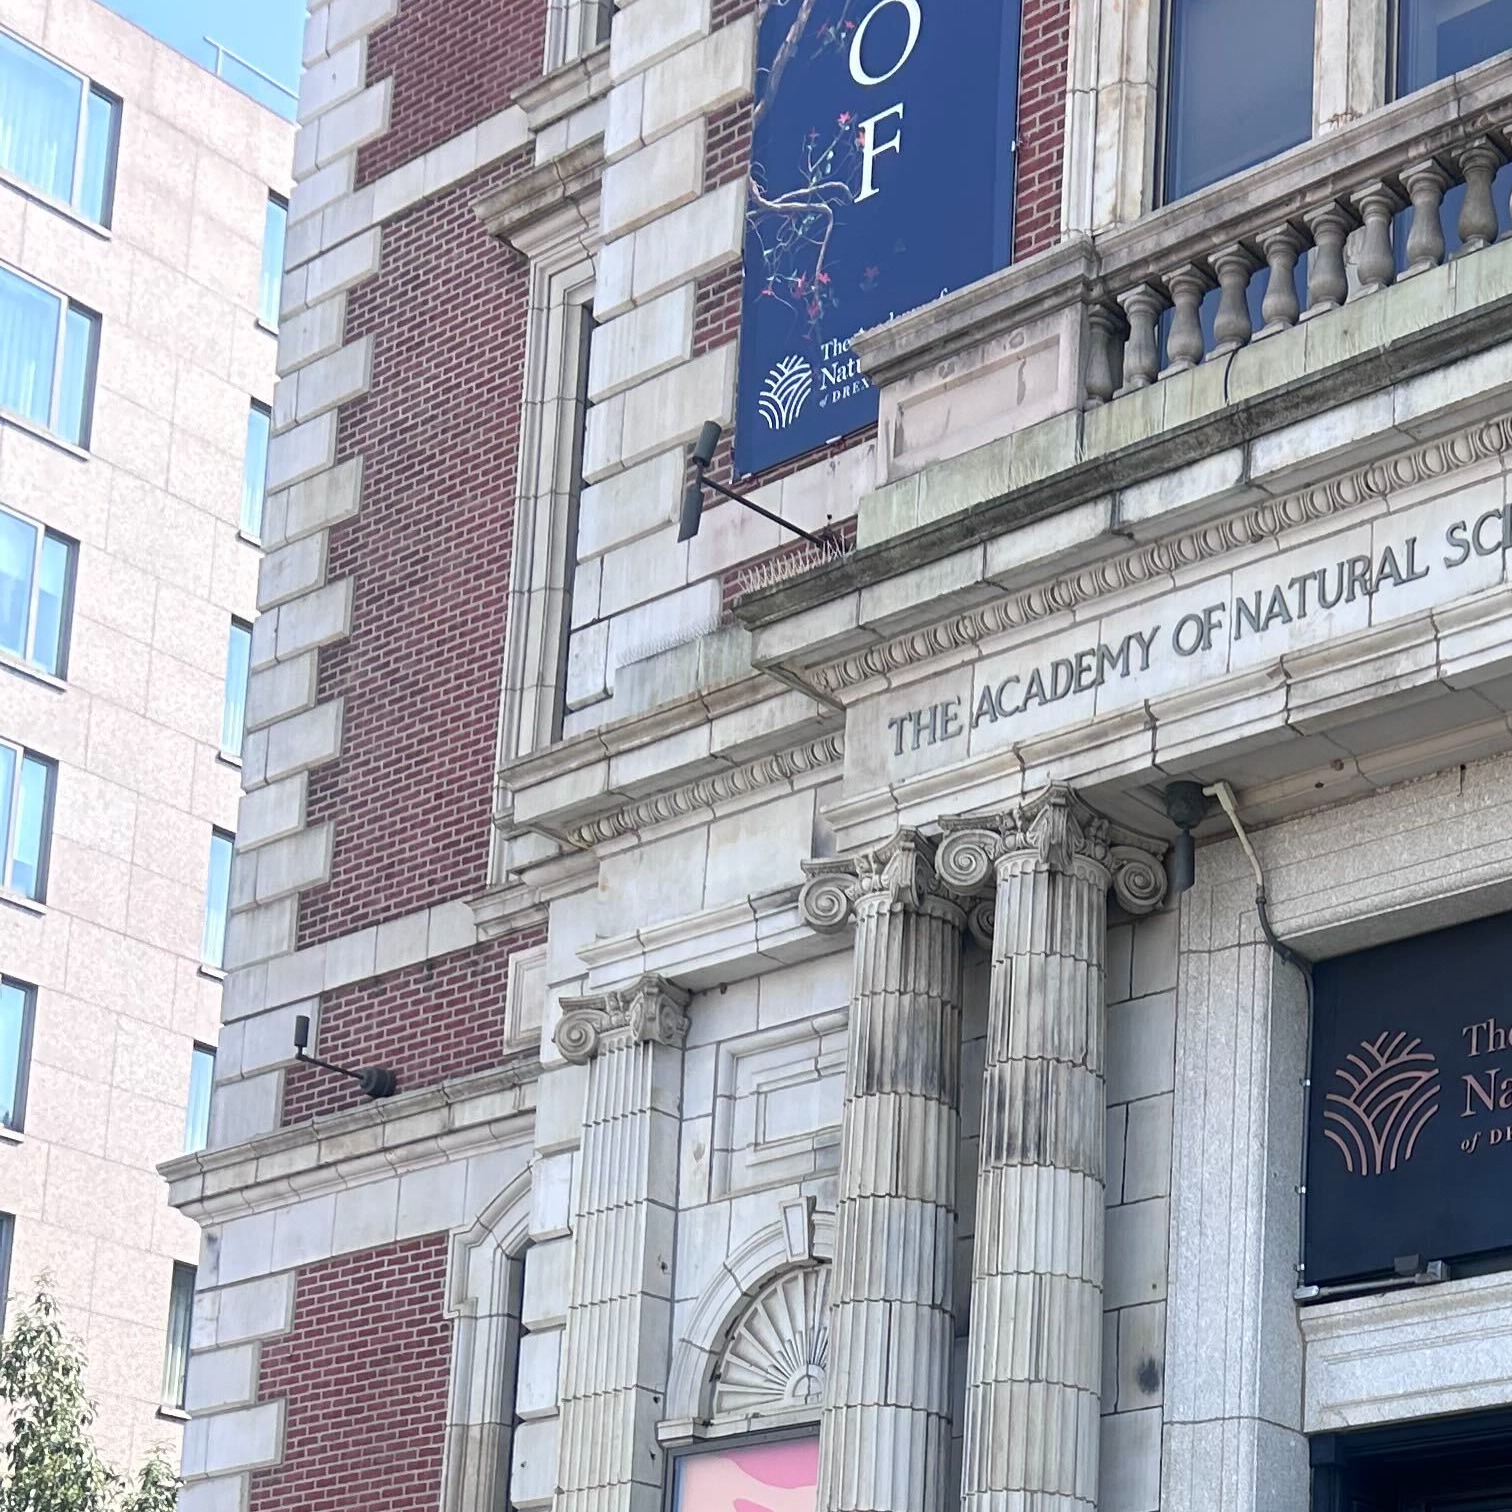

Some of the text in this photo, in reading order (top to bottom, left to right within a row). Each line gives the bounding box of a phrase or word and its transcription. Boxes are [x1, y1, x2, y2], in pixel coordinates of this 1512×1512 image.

[821, 338, 850, 360] The
[888, 700, 963, 756] THE
[971, 625, 1160, 728] ACADEMY
[1172, 603, 1227, 656] OF
[1234, 538, 1429, 640] NATURAL
[1461, 1133, 1482, 1153] of
